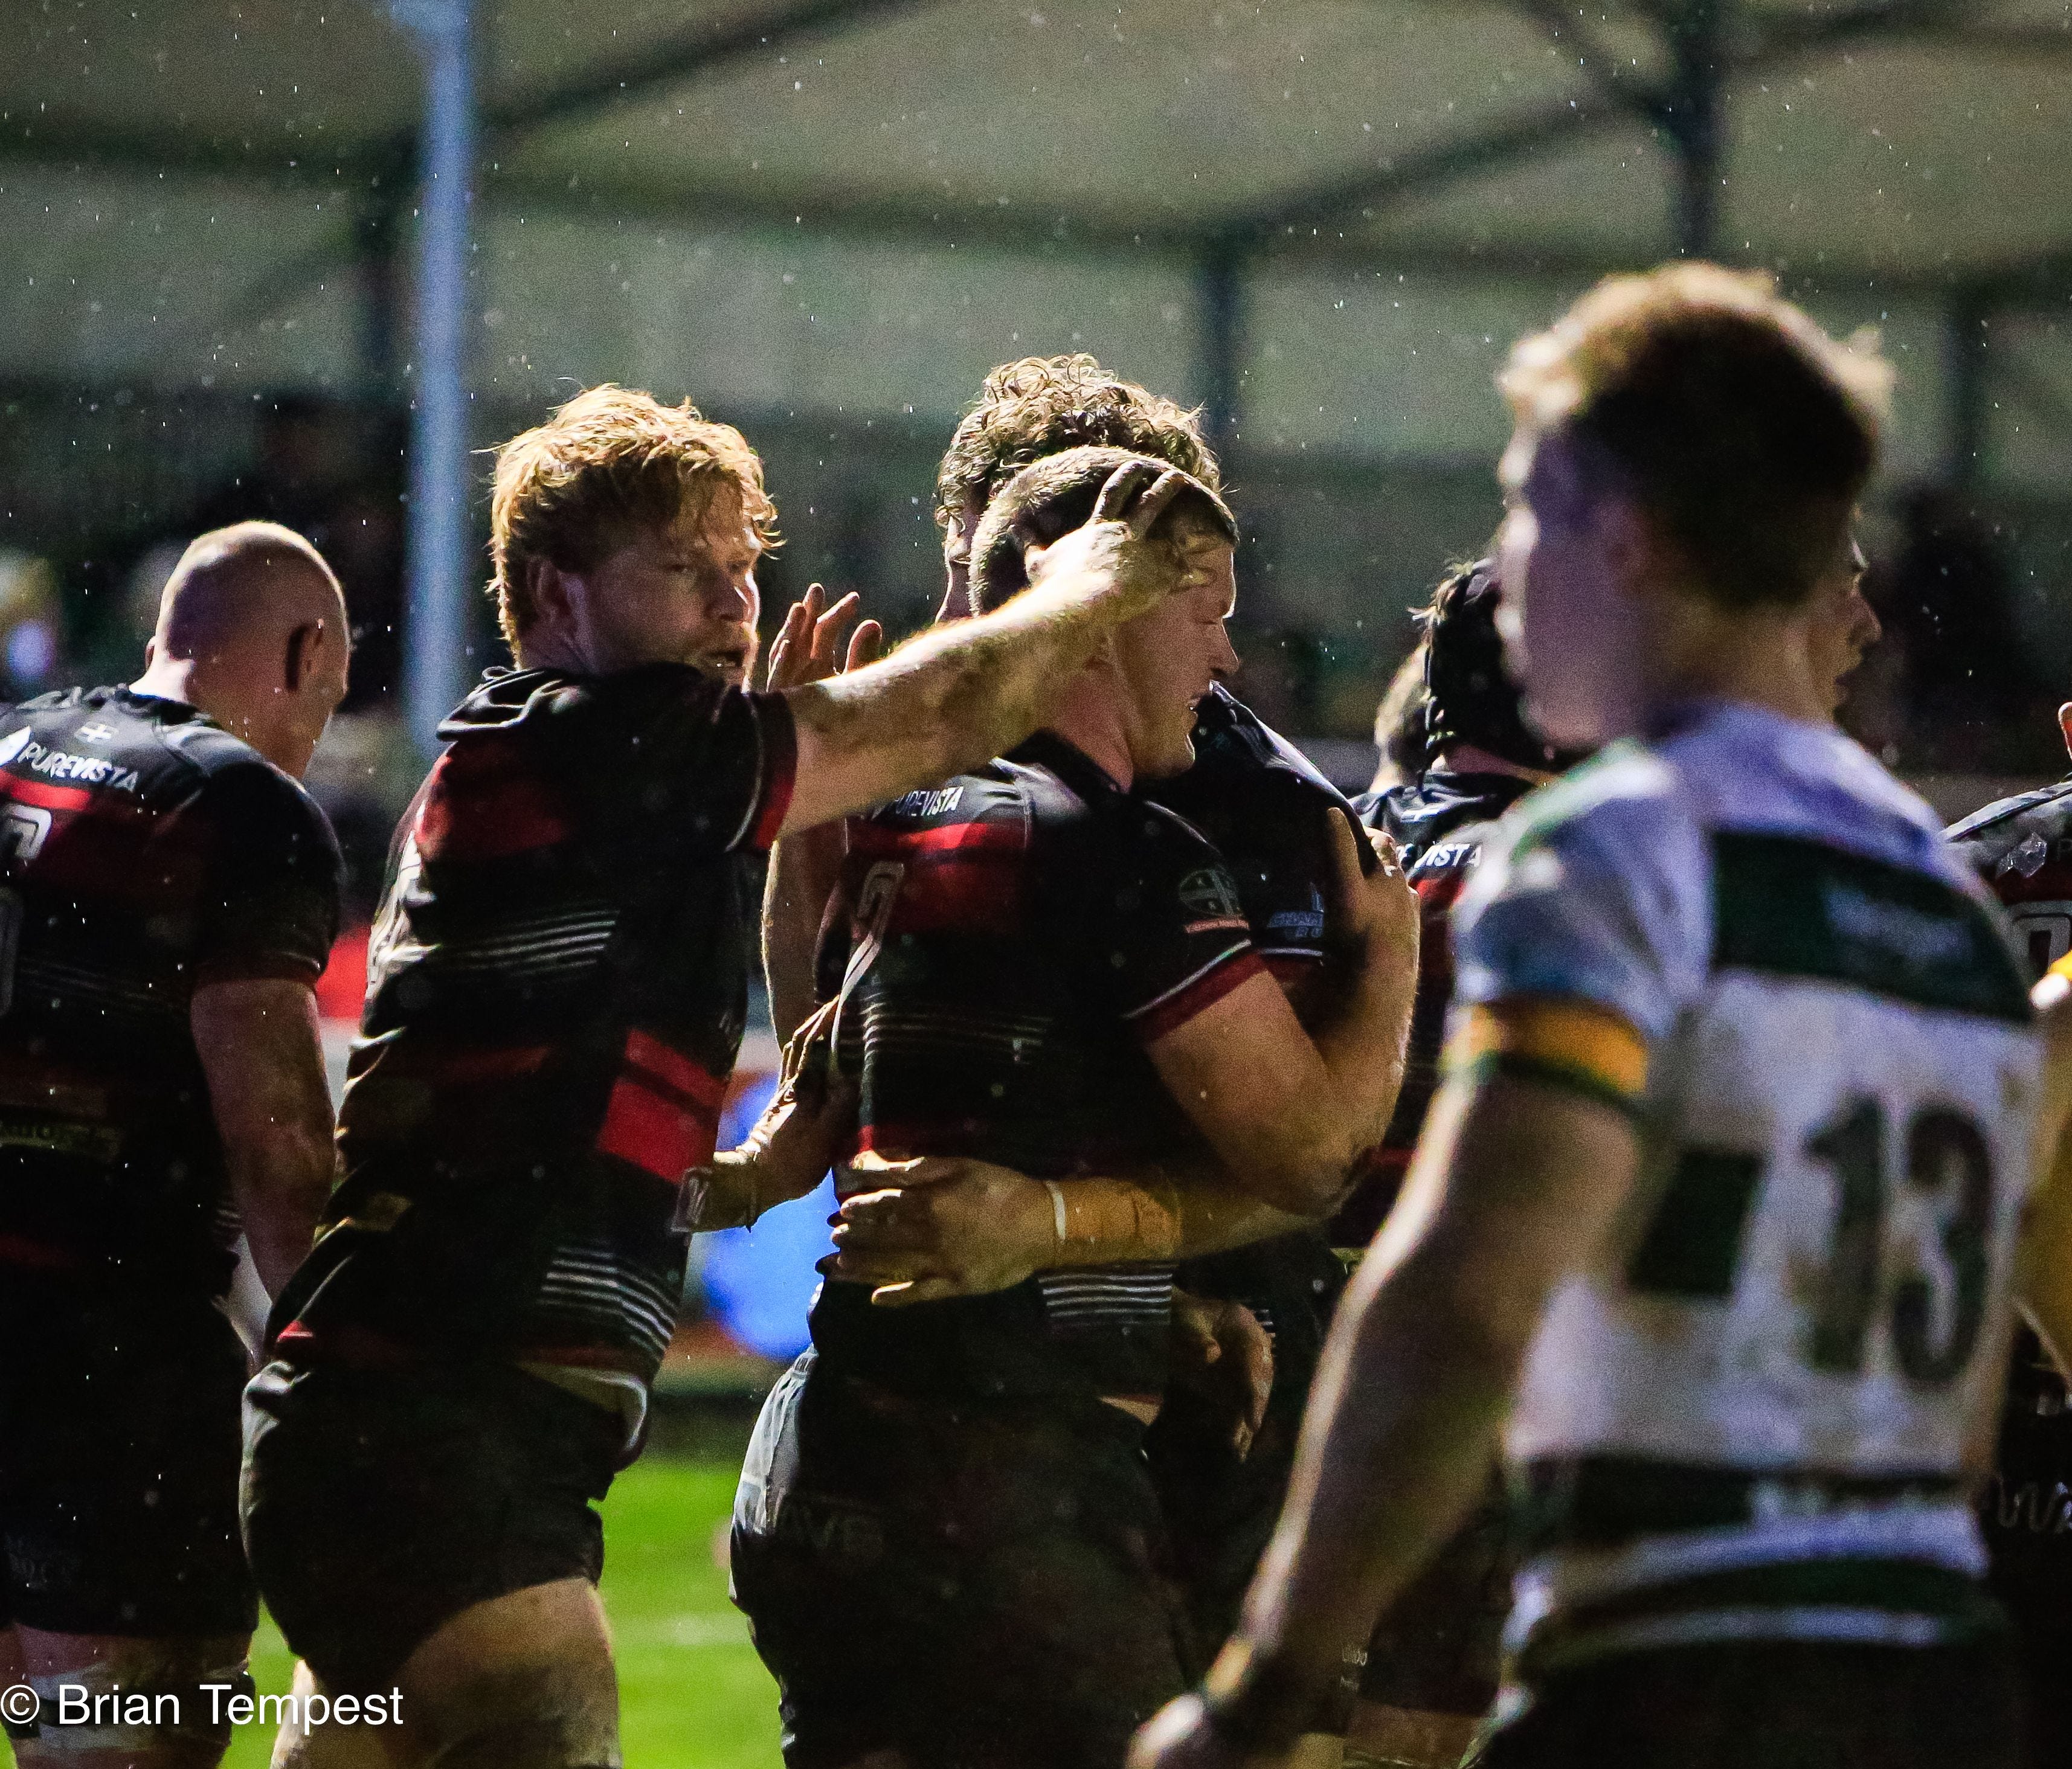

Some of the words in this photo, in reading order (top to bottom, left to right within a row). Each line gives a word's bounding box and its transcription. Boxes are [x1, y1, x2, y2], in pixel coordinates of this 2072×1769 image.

[17, 741, 140, 793] PUREVISTA
[890, 786, 964, 817] UREVISTA
[1803, 1090, 1992, 1389] 13
